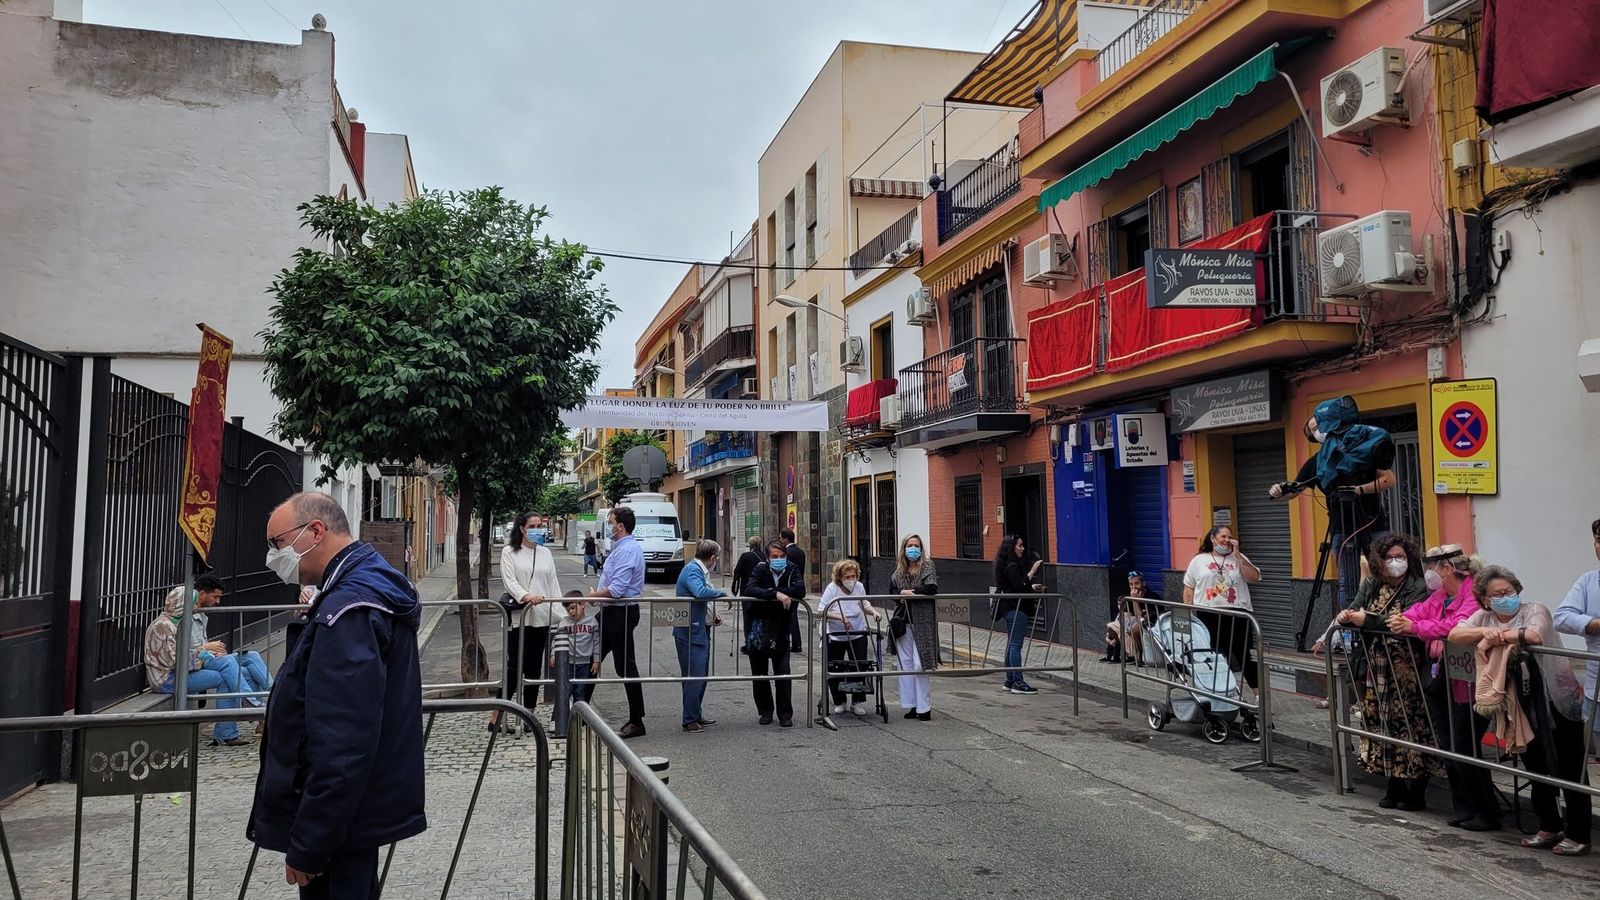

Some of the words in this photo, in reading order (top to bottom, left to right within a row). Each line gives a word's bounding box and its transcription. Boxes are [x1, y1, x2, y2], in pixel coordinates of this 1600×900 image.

[1179, 252, 1222, 267] Mónica
[1224, 253, 1254, 267] Misa
[1190, 287, 1213, 296] RAYOS
[1214, 287, 1229, 296] UVA
[1235, 286, 1255, 296] UÑAS
[1221, 296, 1231, 304] 954
[1233, 296, 1243, 304] 661
[1244, 296, 1255, 304] 516
[1192, 385, 1233, 399] Mónica
[1236, 378, 1267, 392] Misa
[590, 399, 621, 408] LUGAR
[622, 400, 654, 409] DONDE
[656, 401, 667, 409] LA
[669, 401, 686, 410] LUZ
[688, 402, 699, 410] DE
[702, 402, 713, 410] TU
[714, 402, 744, 411] PODER
[745, 403, 759, 411] NO
[1211, 409, 1231, 419] RAYOS
[1231, 408, 1244, 417] UVA
[1249, 402, 1268, 415] UÑAS
[651, 420, 675, 428] GRUPO
